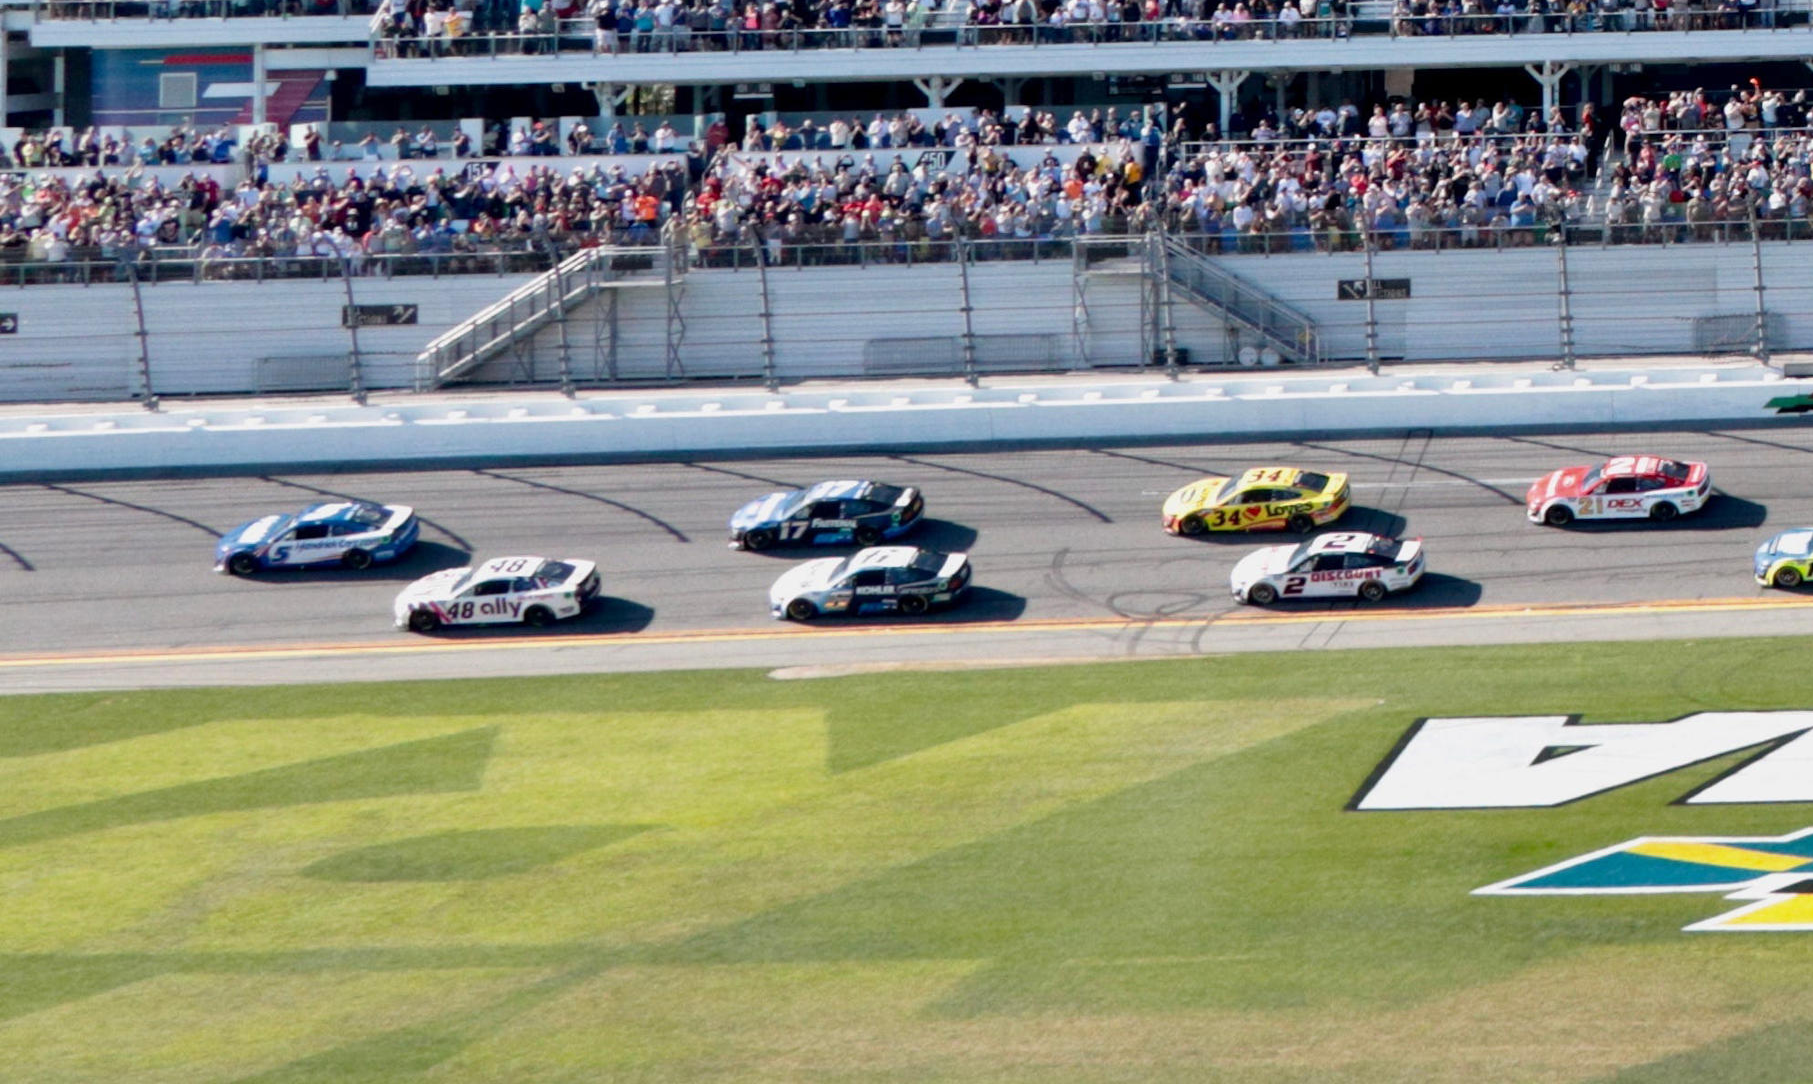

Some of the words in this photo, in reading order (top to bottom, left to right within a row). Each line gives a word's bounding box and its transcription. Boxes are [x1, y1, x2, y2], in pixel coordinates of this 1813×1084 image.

[1250, 470, 1281, 483] 34
[1578, 497, 1604, 515] 21
[1607, 499, 1644, 508] DEX
[1213, 509, 1242, 526] 34
[780, 520, 809, 540] 17
[1322, 535, 1355, 548] 2
[269, 546, 290, 563] 5
[490, 559, 529, 573] 48
[1310, 567, 1383, 583] DISCOUNT
[857, 586, 896, 595] KOHLER
[1283, 576, 1307, 595] 2
[447, 602, 475, 619] 48
[481, 598, 522, 618] ally
